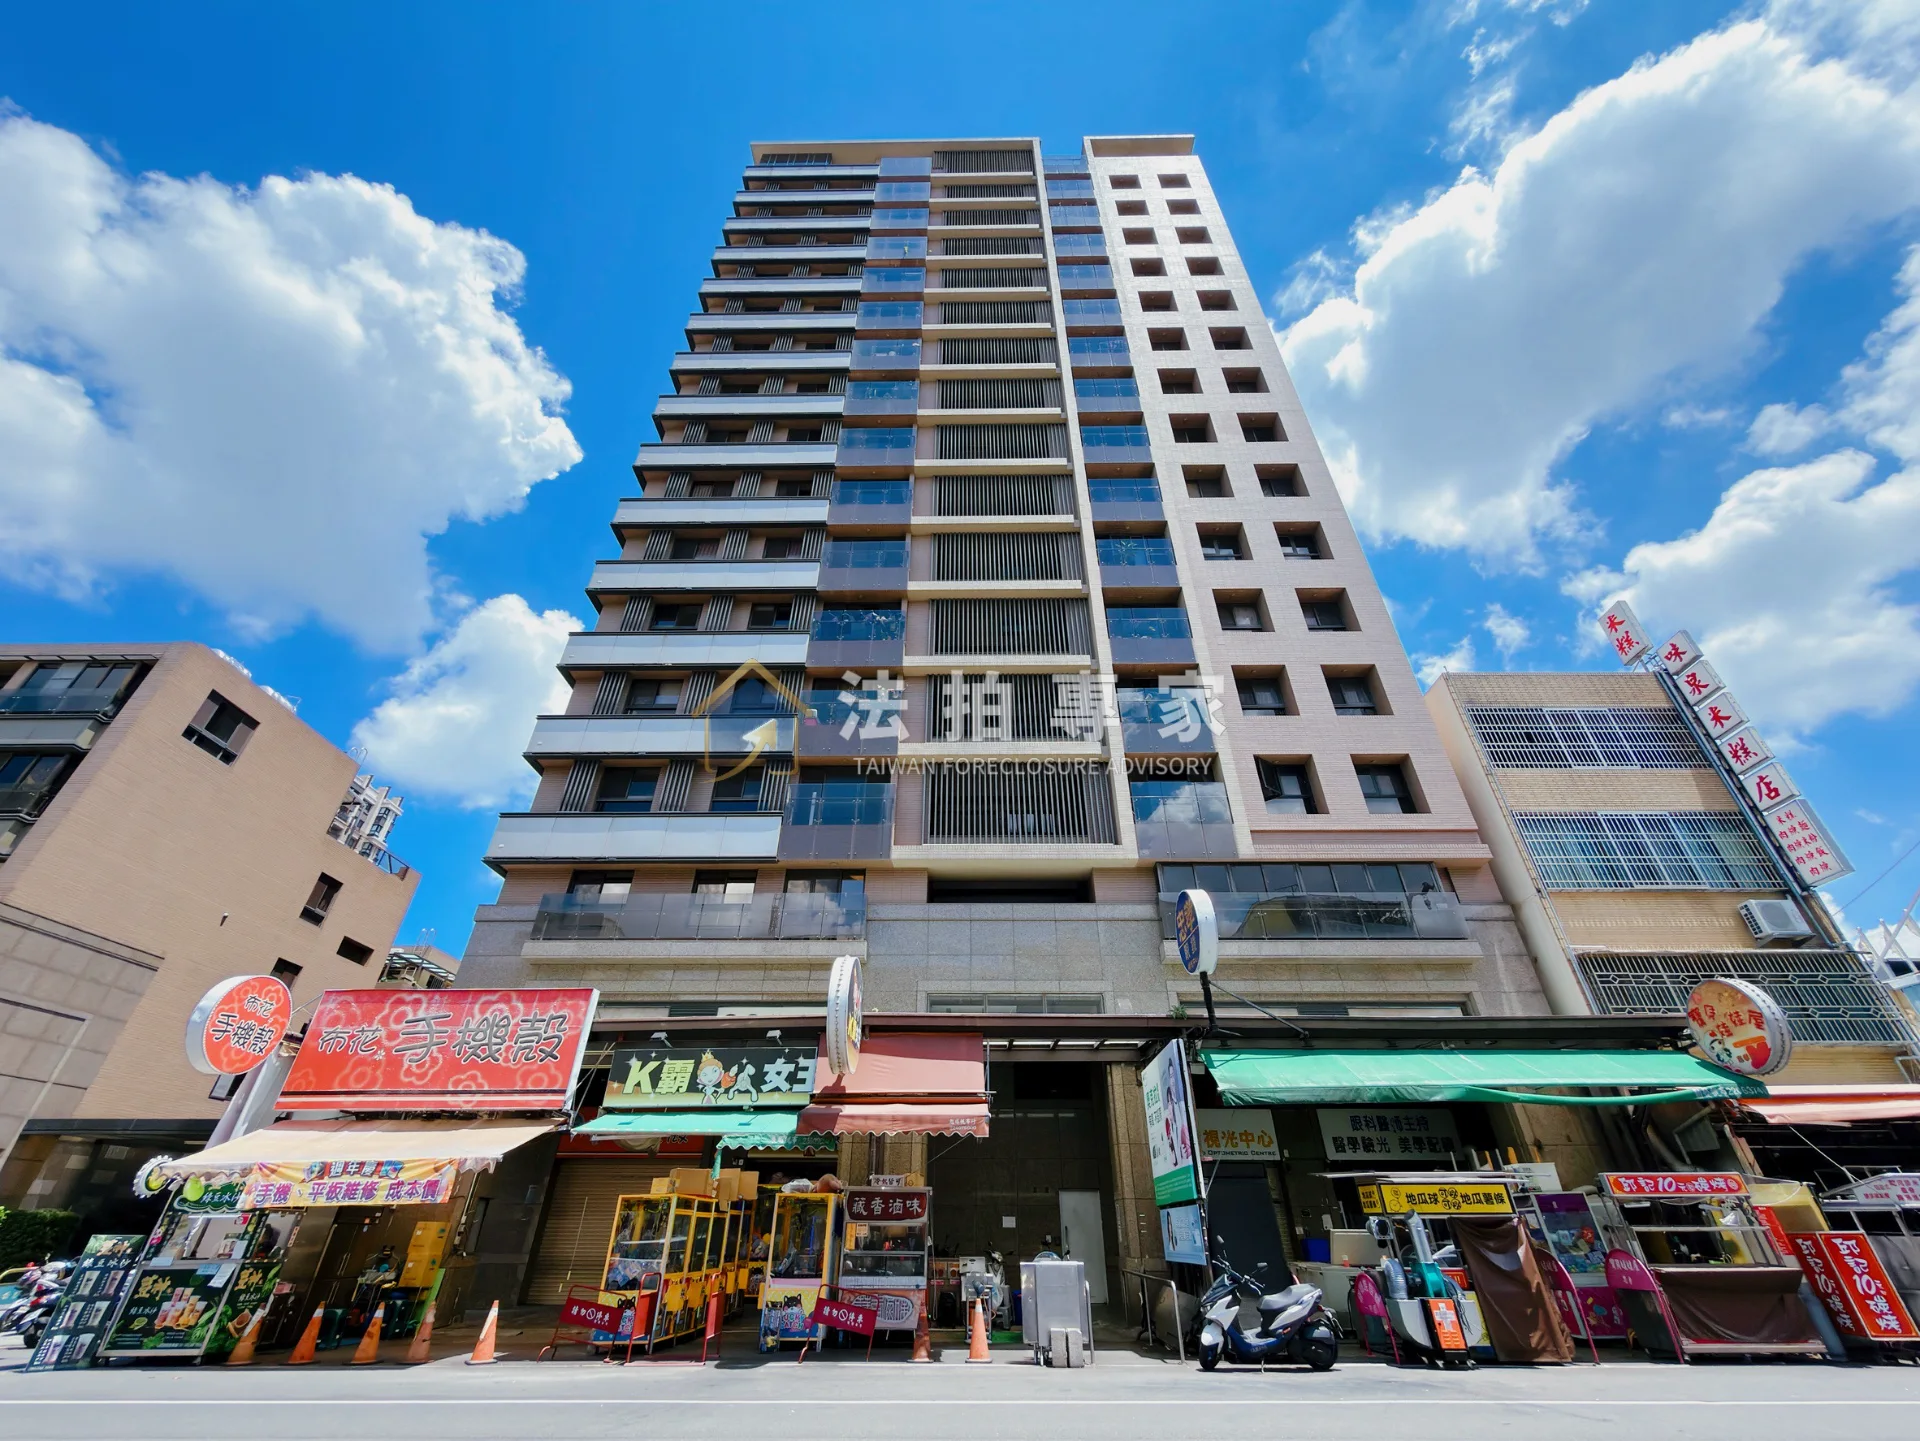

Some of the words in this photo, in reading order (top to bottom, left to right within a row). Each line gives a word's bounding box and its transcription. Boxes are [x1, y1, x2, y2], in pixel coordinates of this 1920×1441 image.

[1606, 614, 1640, 656] 米糕
[244, 995, 275, 1018] 布花
[210, 1012, 275, 1055] 手機殼
[1203, 1129, 1274, 1149] 視光中心
[329, 1160, 378, 1177] 週年慶
[386, 1179, 442, 1200] 成本價
